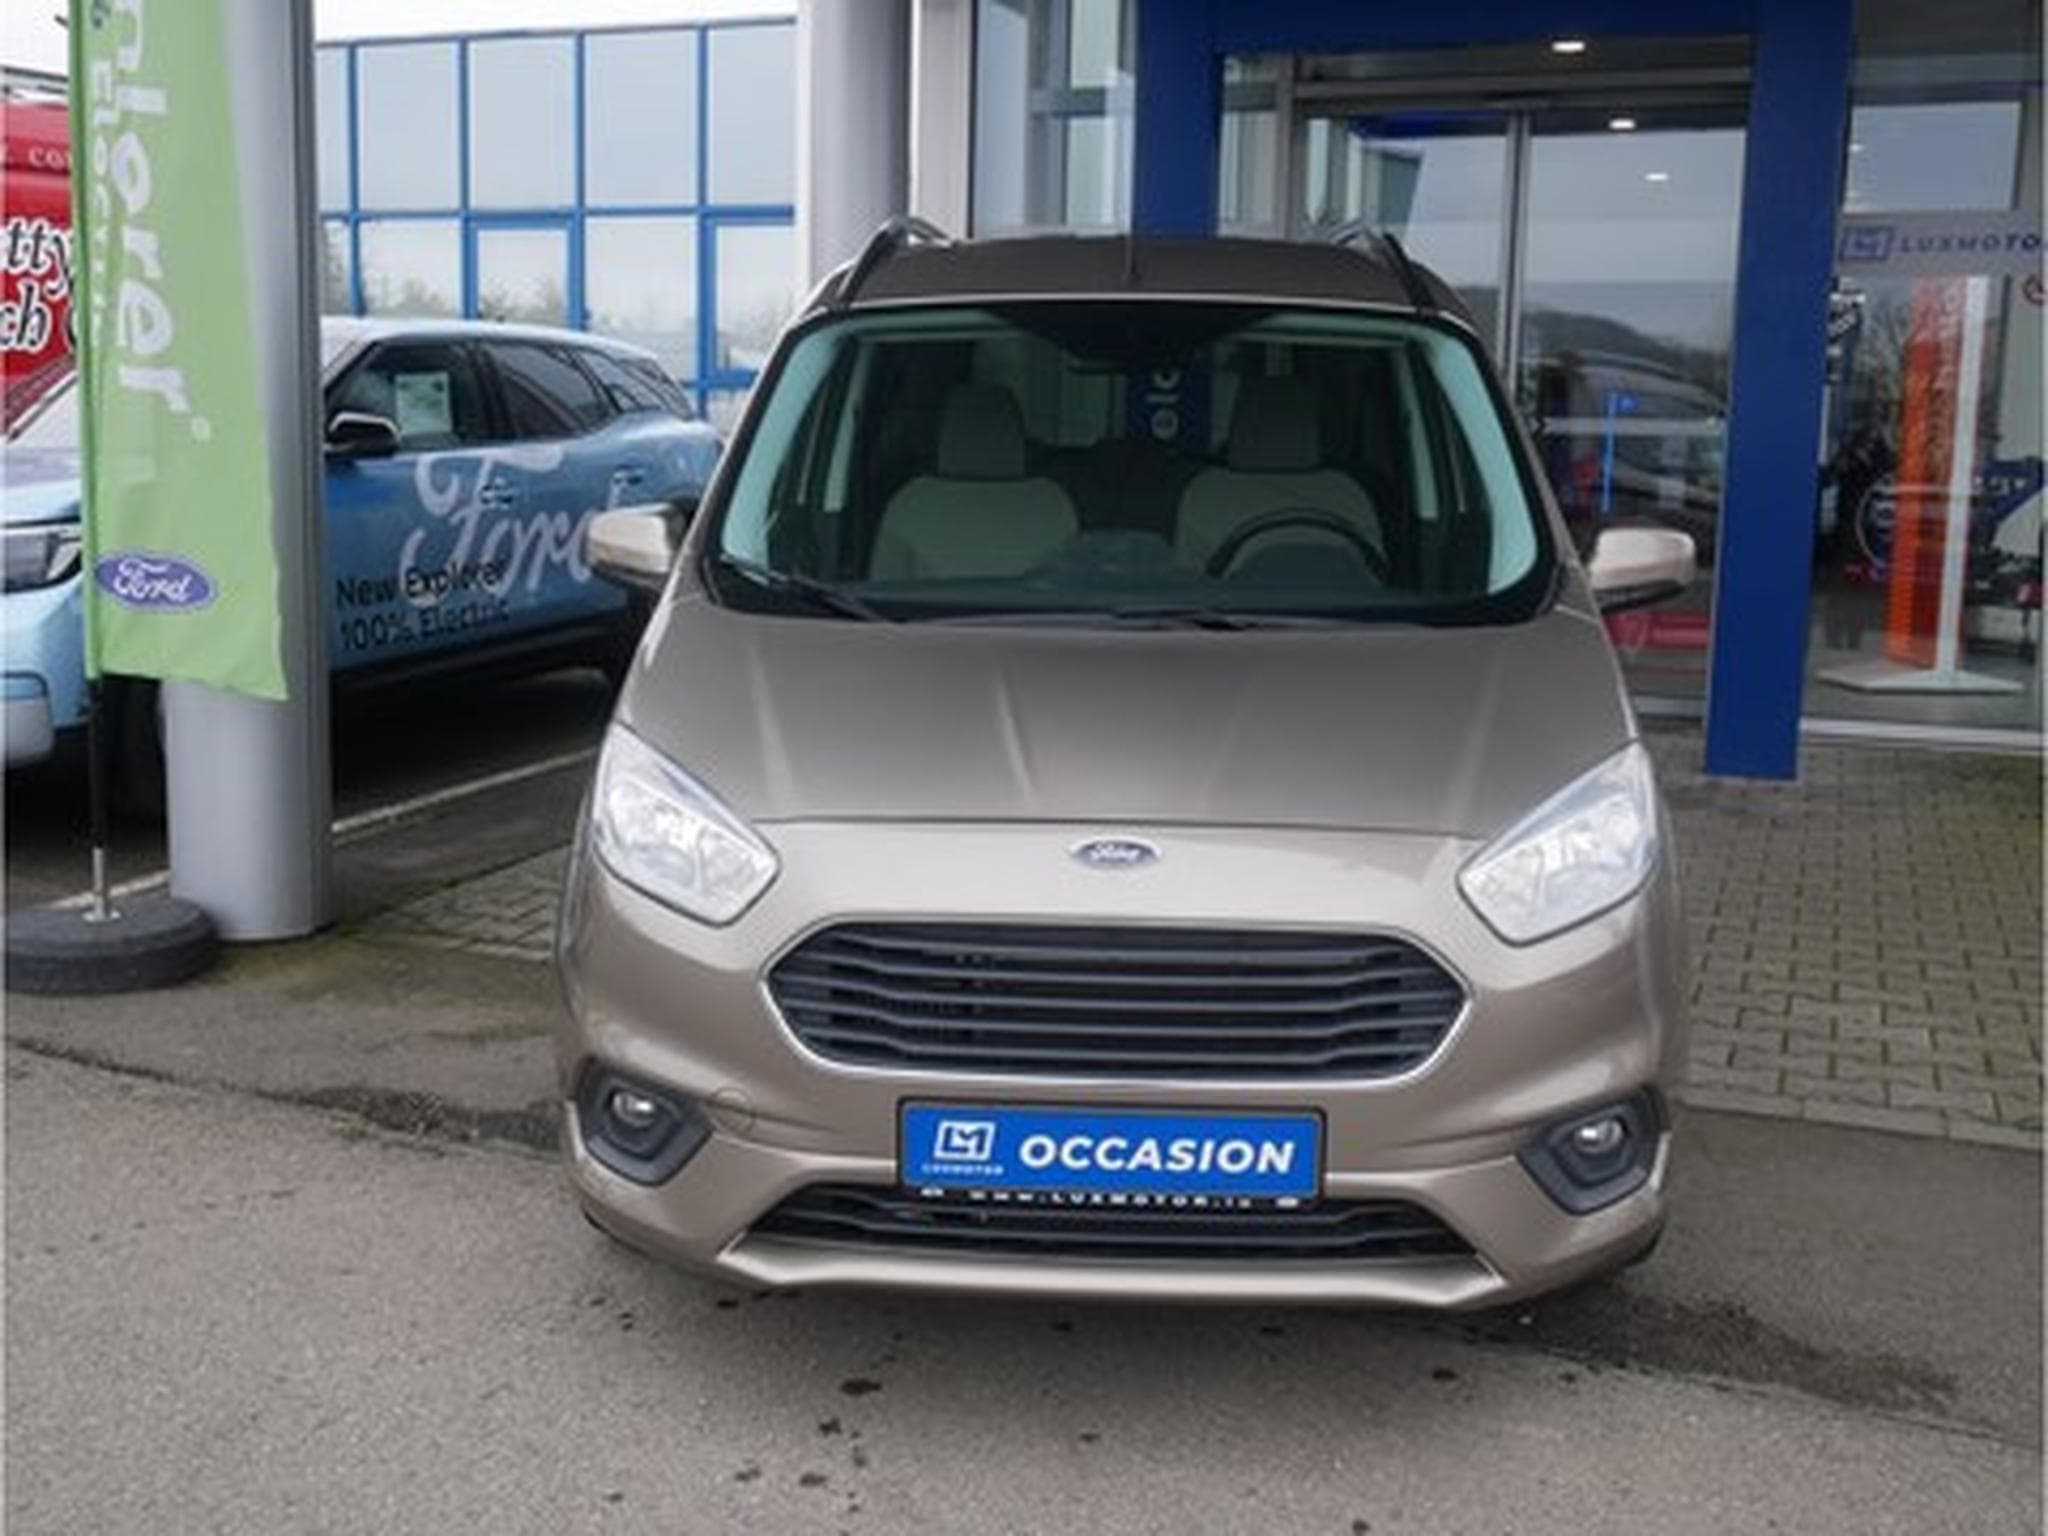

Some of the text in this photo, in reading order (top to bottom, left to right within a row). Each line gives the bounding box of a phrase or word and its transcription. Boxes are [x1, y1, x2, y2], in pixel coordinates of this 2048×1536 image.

[113, 560, 192, 602] Ford
[336, 559, 509, 609] New Explorer
[340, 597, 511, 650] 100% Electric
[1019, 1134, 1296, 1175] OCCASION
